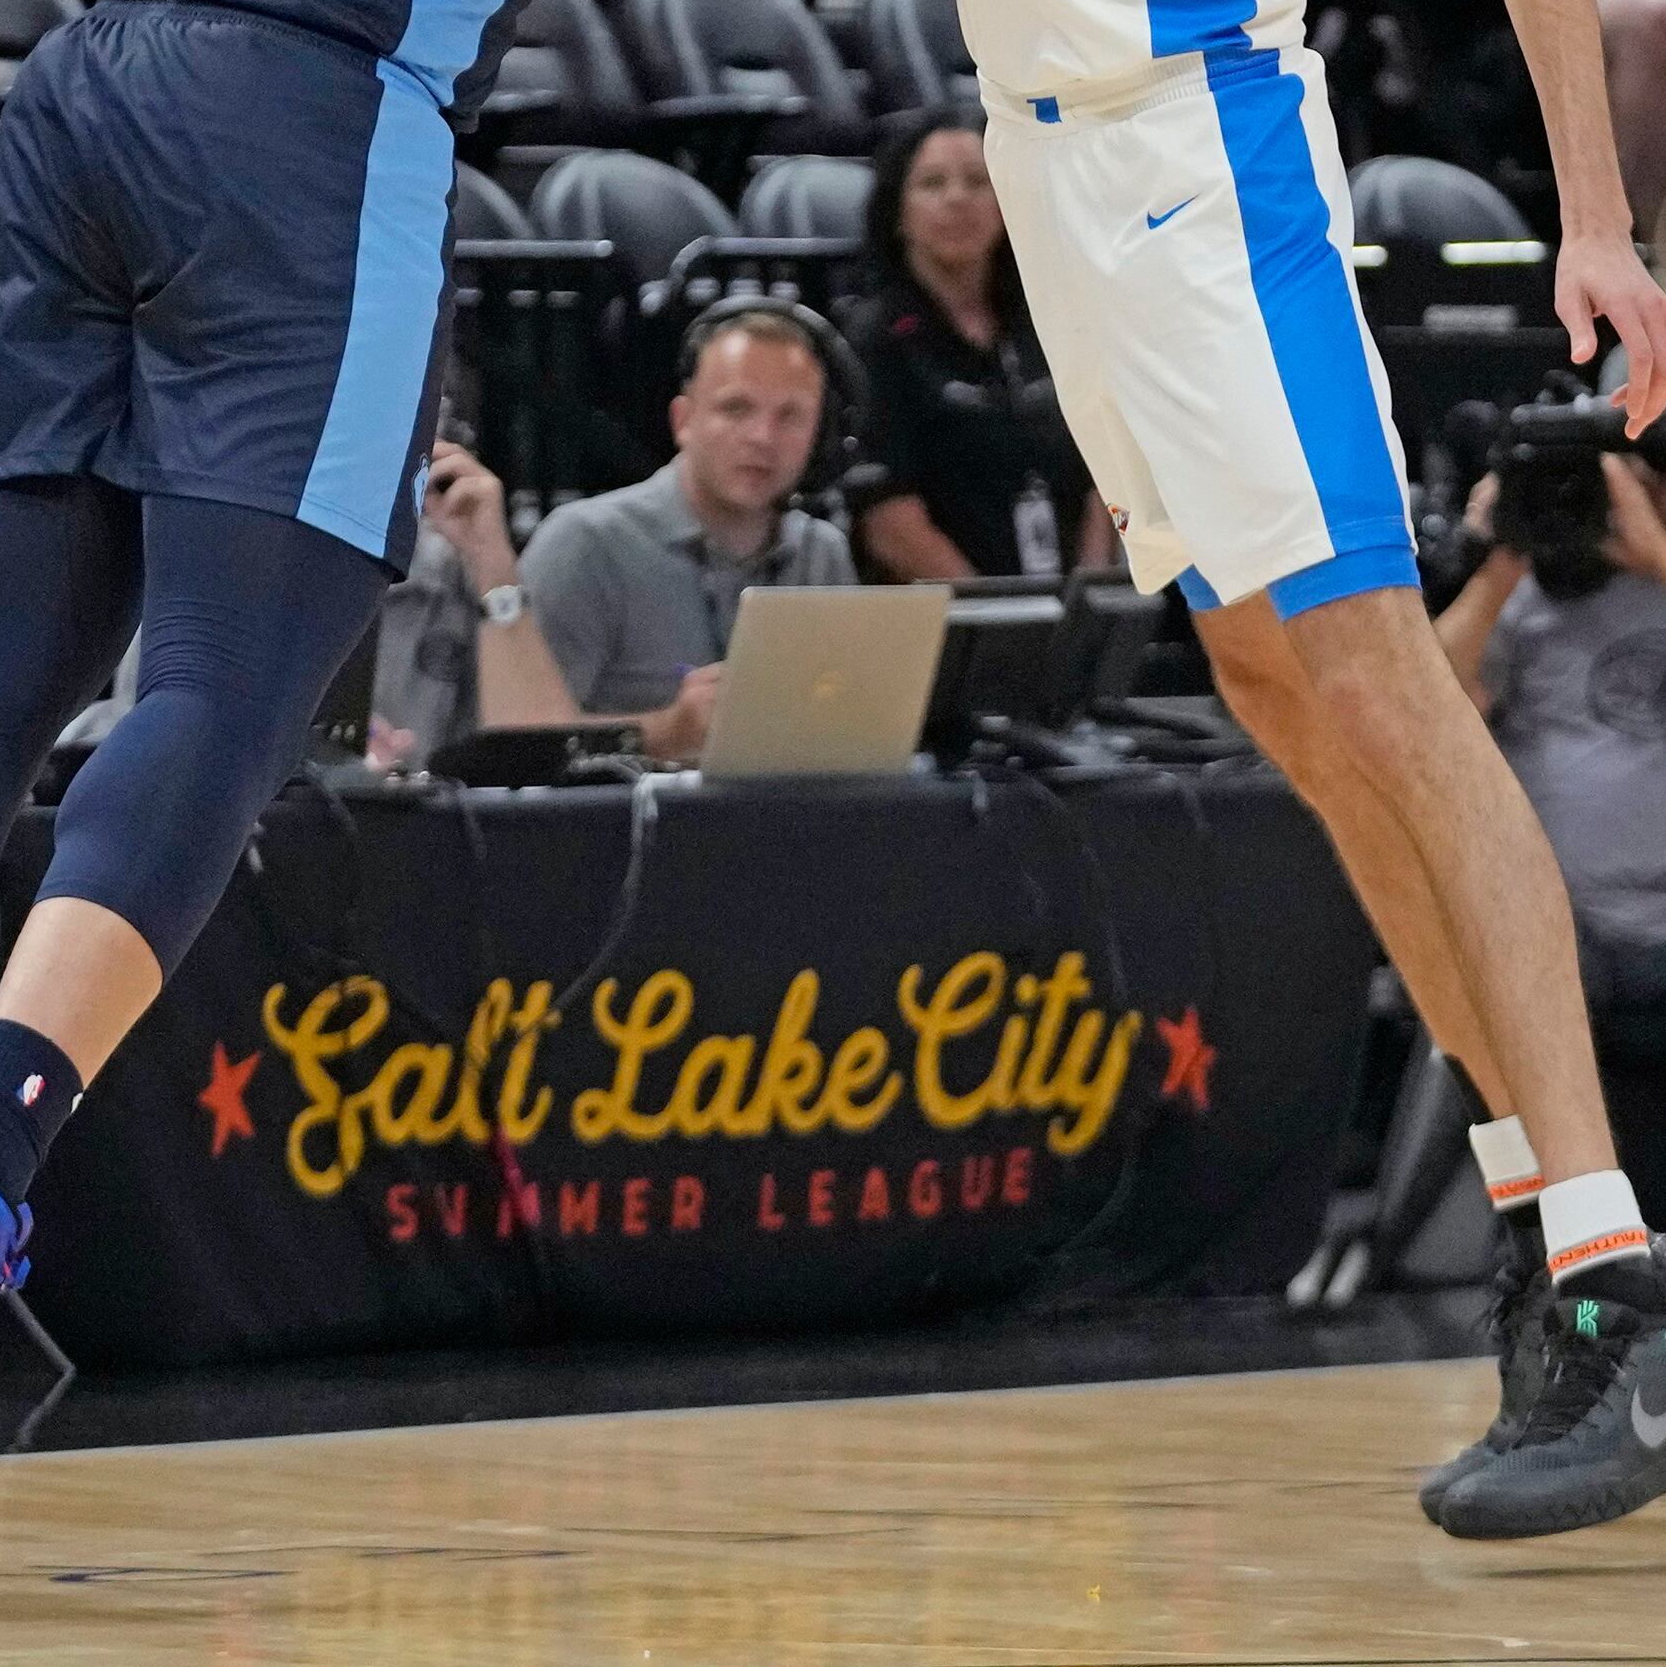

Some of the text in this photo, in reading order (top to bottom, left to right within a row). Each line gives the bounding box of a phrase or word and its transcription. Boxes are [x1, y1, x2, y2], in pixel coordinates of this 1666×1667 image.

[262, 949, 1142, 1198] Salt Lake City
[756, 1145, 1035, 1231] LEAGUE
